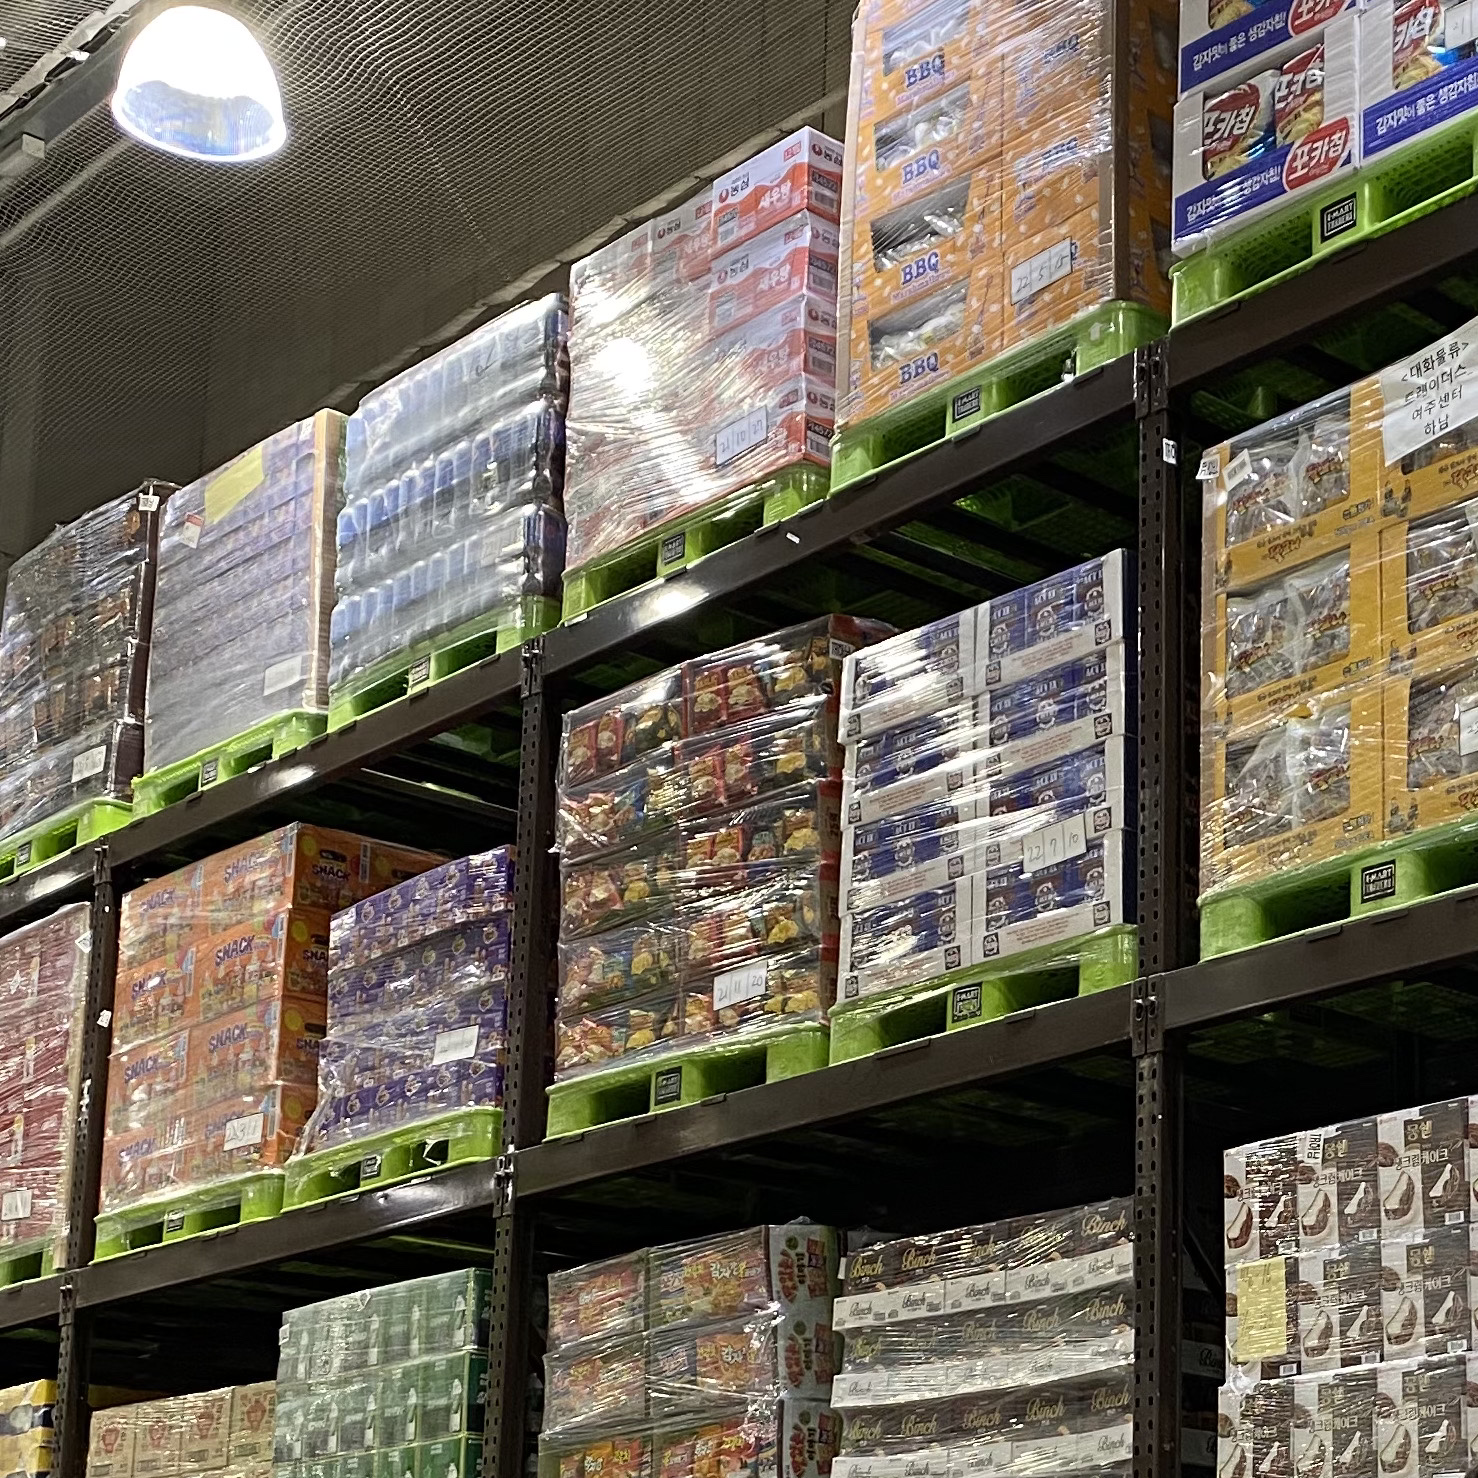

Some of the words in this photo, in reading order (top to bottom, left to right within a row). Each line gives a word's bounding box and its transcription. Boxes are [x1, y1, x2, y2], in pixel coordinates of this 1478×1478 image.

[1228, 32, 1246, 54] 좋은
[1247, 14, 1286, 44] 생감자칩!
[905, 54, 945, 89] BBQ
[1375, 105, 1416, 134] 감자맛이
[1416, 93, 1436, 115] 좋은
[902, 149, 940, 184] BBQ
[1288, 129, 1347, 178] 포카칩
[901, 251, 939, 285] BBQ
[1016, 276, 1030, 294] 22
[899, 350, 939, 384] BBQ
[1401, 341, 1469, 381] <대화물류>
[1412, 384, 1462, 420] 여주센터
[1424, 414, 1448, 435] 하남
[312, 864, 350, 880] SNACK
[215, 935, 254, 966] SNACK
[209, 1023, 248, 1051] SNACK
[1081, 1211, 1128, 1236] Binch
[850, 1256, 884, 1278] Binch
[1026, 1396, 1066, 1422] Binch
[902, 1415, 938, 1436] Binch
